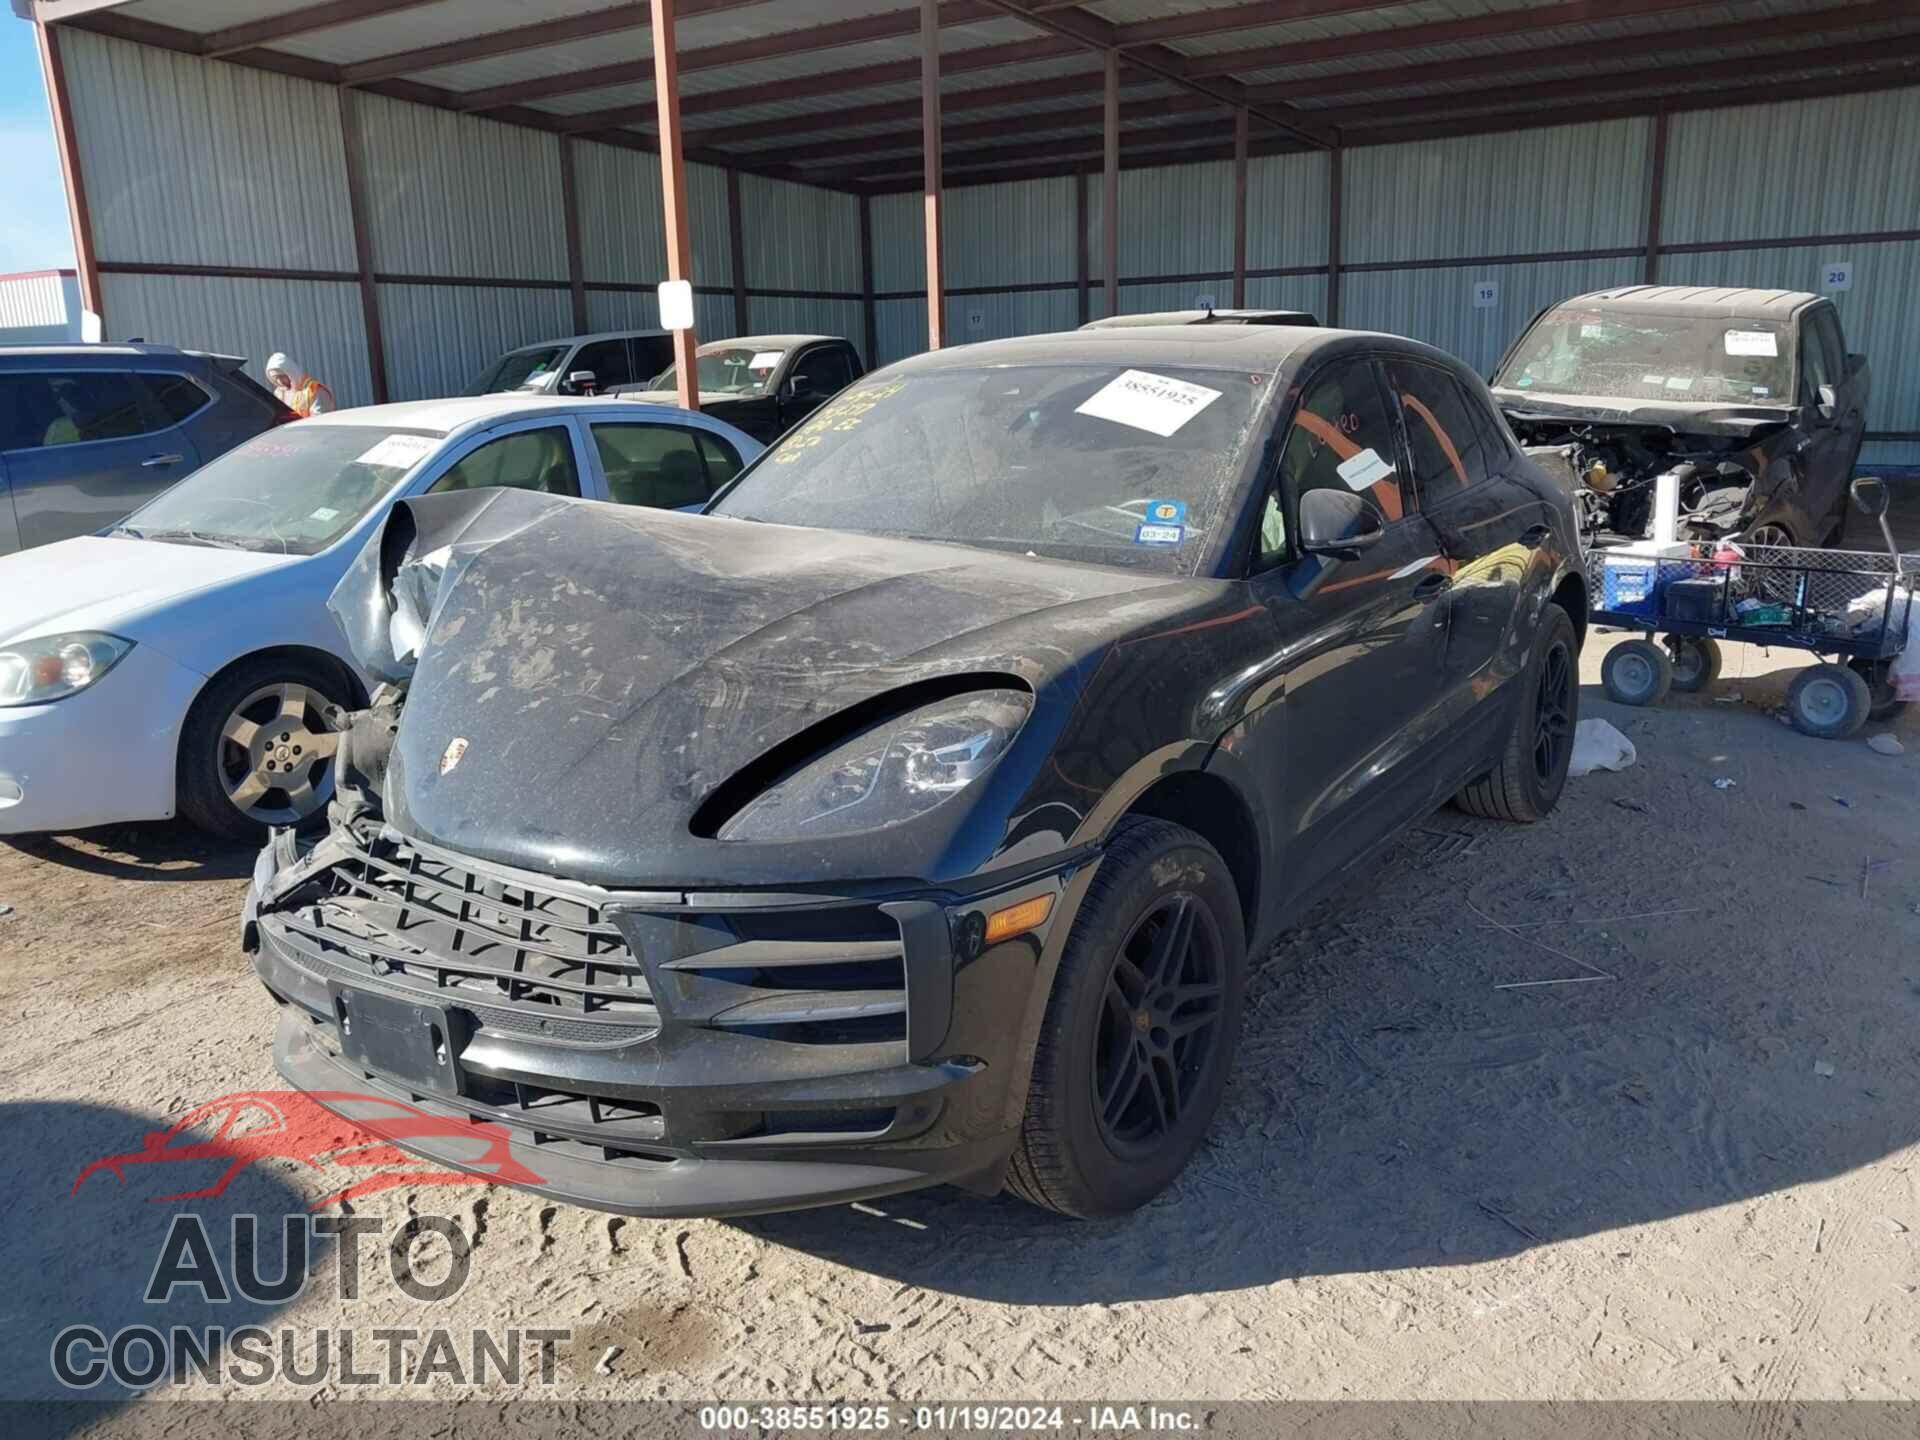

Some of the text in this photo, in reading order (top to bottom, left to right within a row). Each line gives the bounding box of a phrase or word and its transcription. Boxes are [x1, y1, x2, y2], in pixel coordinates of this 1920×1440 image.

[1829, 271, 1846, 283] 20
[1479, 289, 1494, 300] 19
[971, 315, 982, 325] 17
